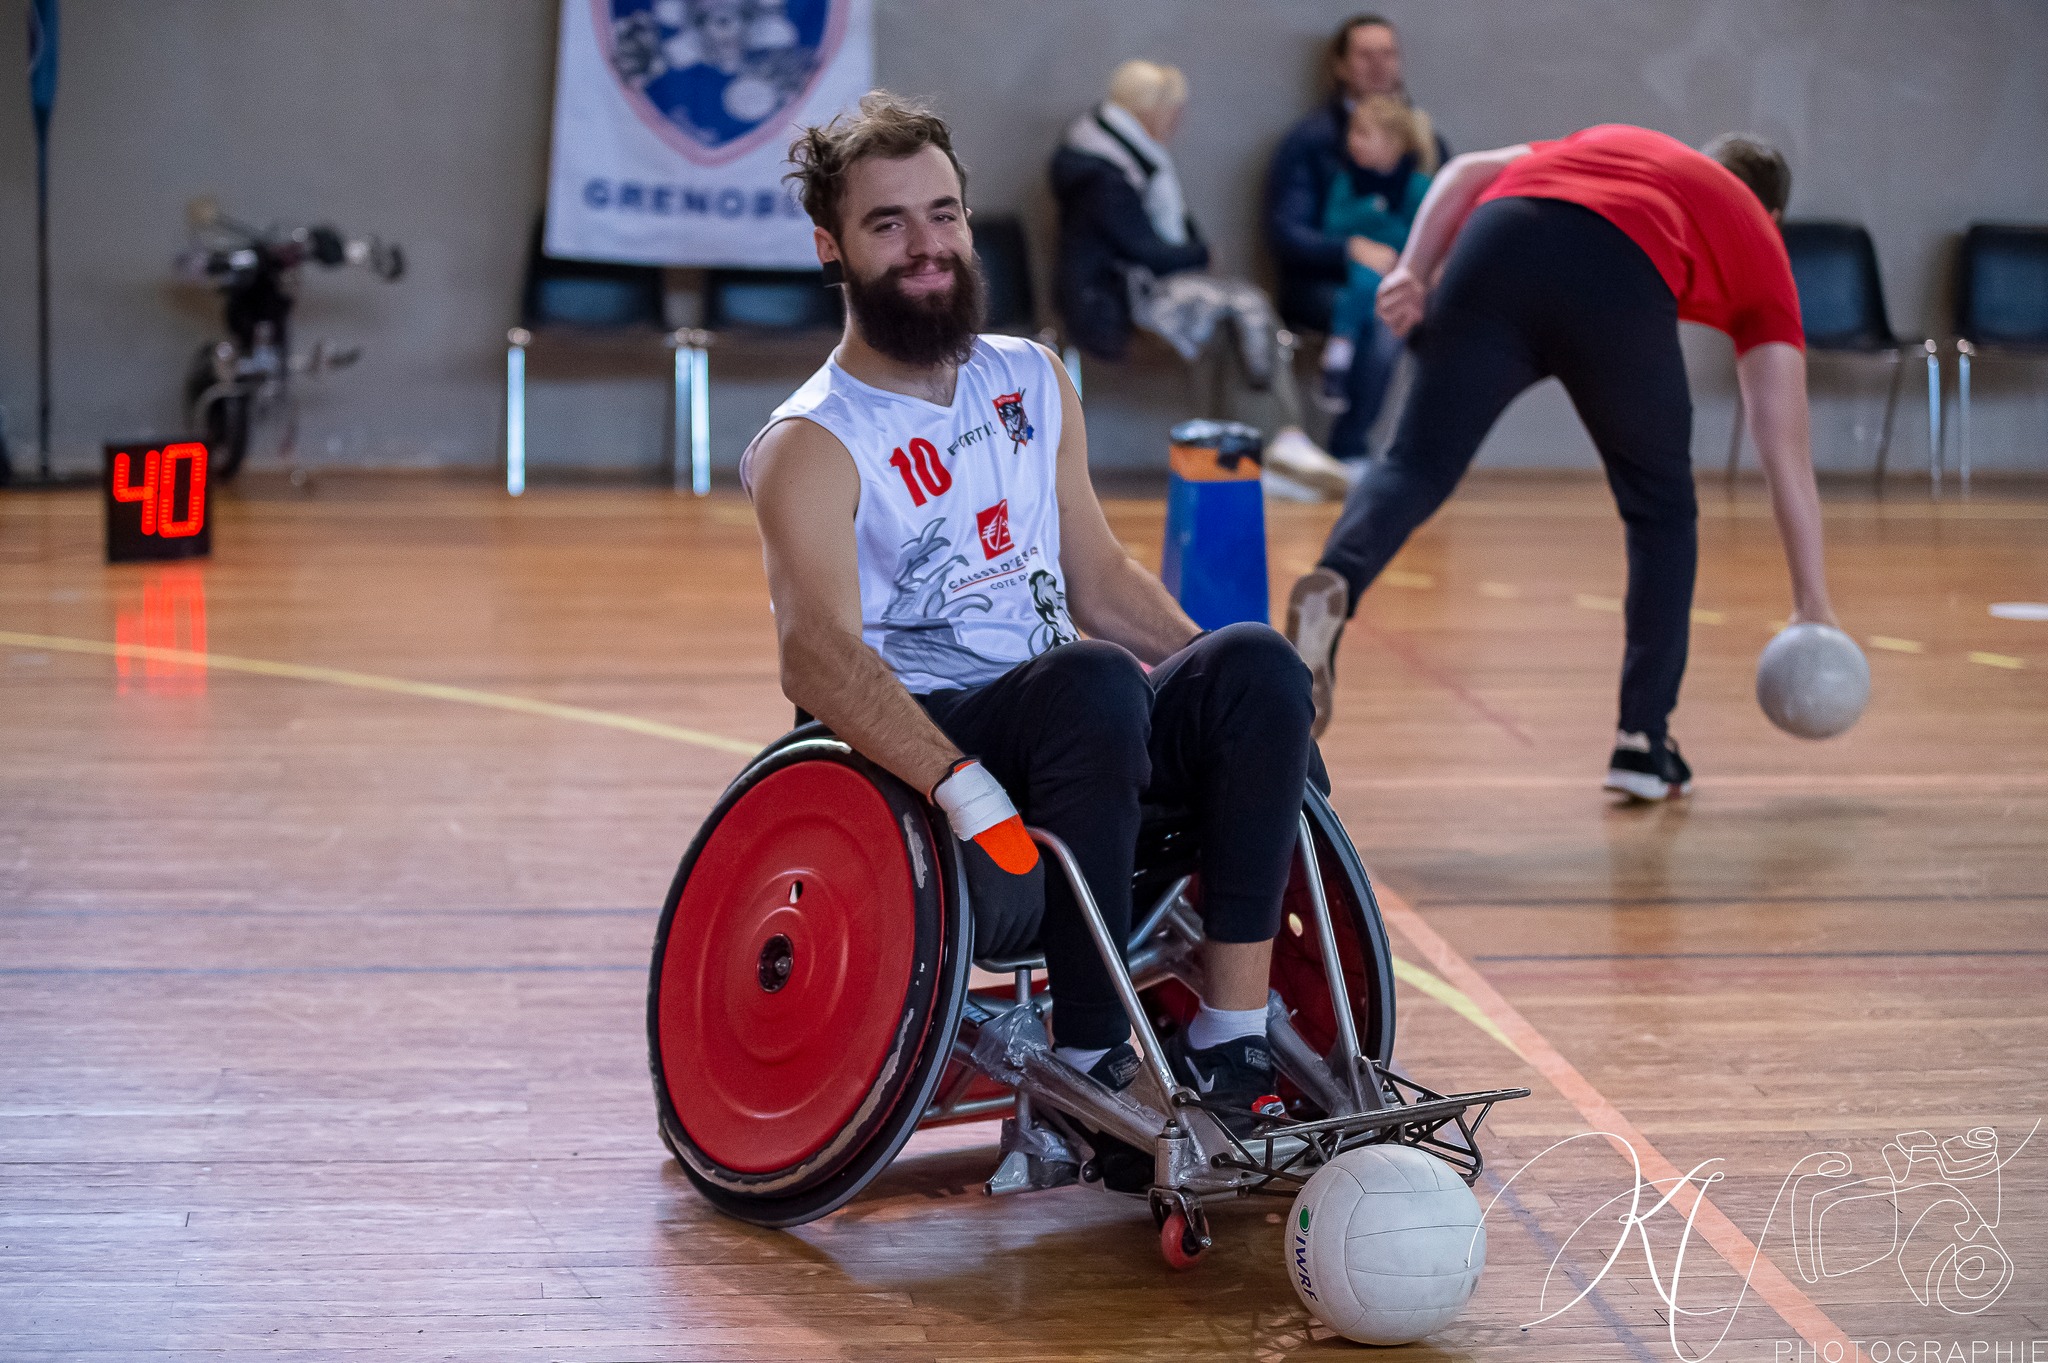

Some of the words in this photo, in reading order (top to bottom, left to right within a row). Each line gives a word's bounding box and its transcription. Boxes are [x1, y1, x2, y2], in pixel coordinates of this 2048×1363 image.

[113, 442, 208, 538] 40
[889, 437, 953, 507] 10
[948, 567, 998, 590] CAISSE
[1295, 1235, 1319, 1302] IWRF
